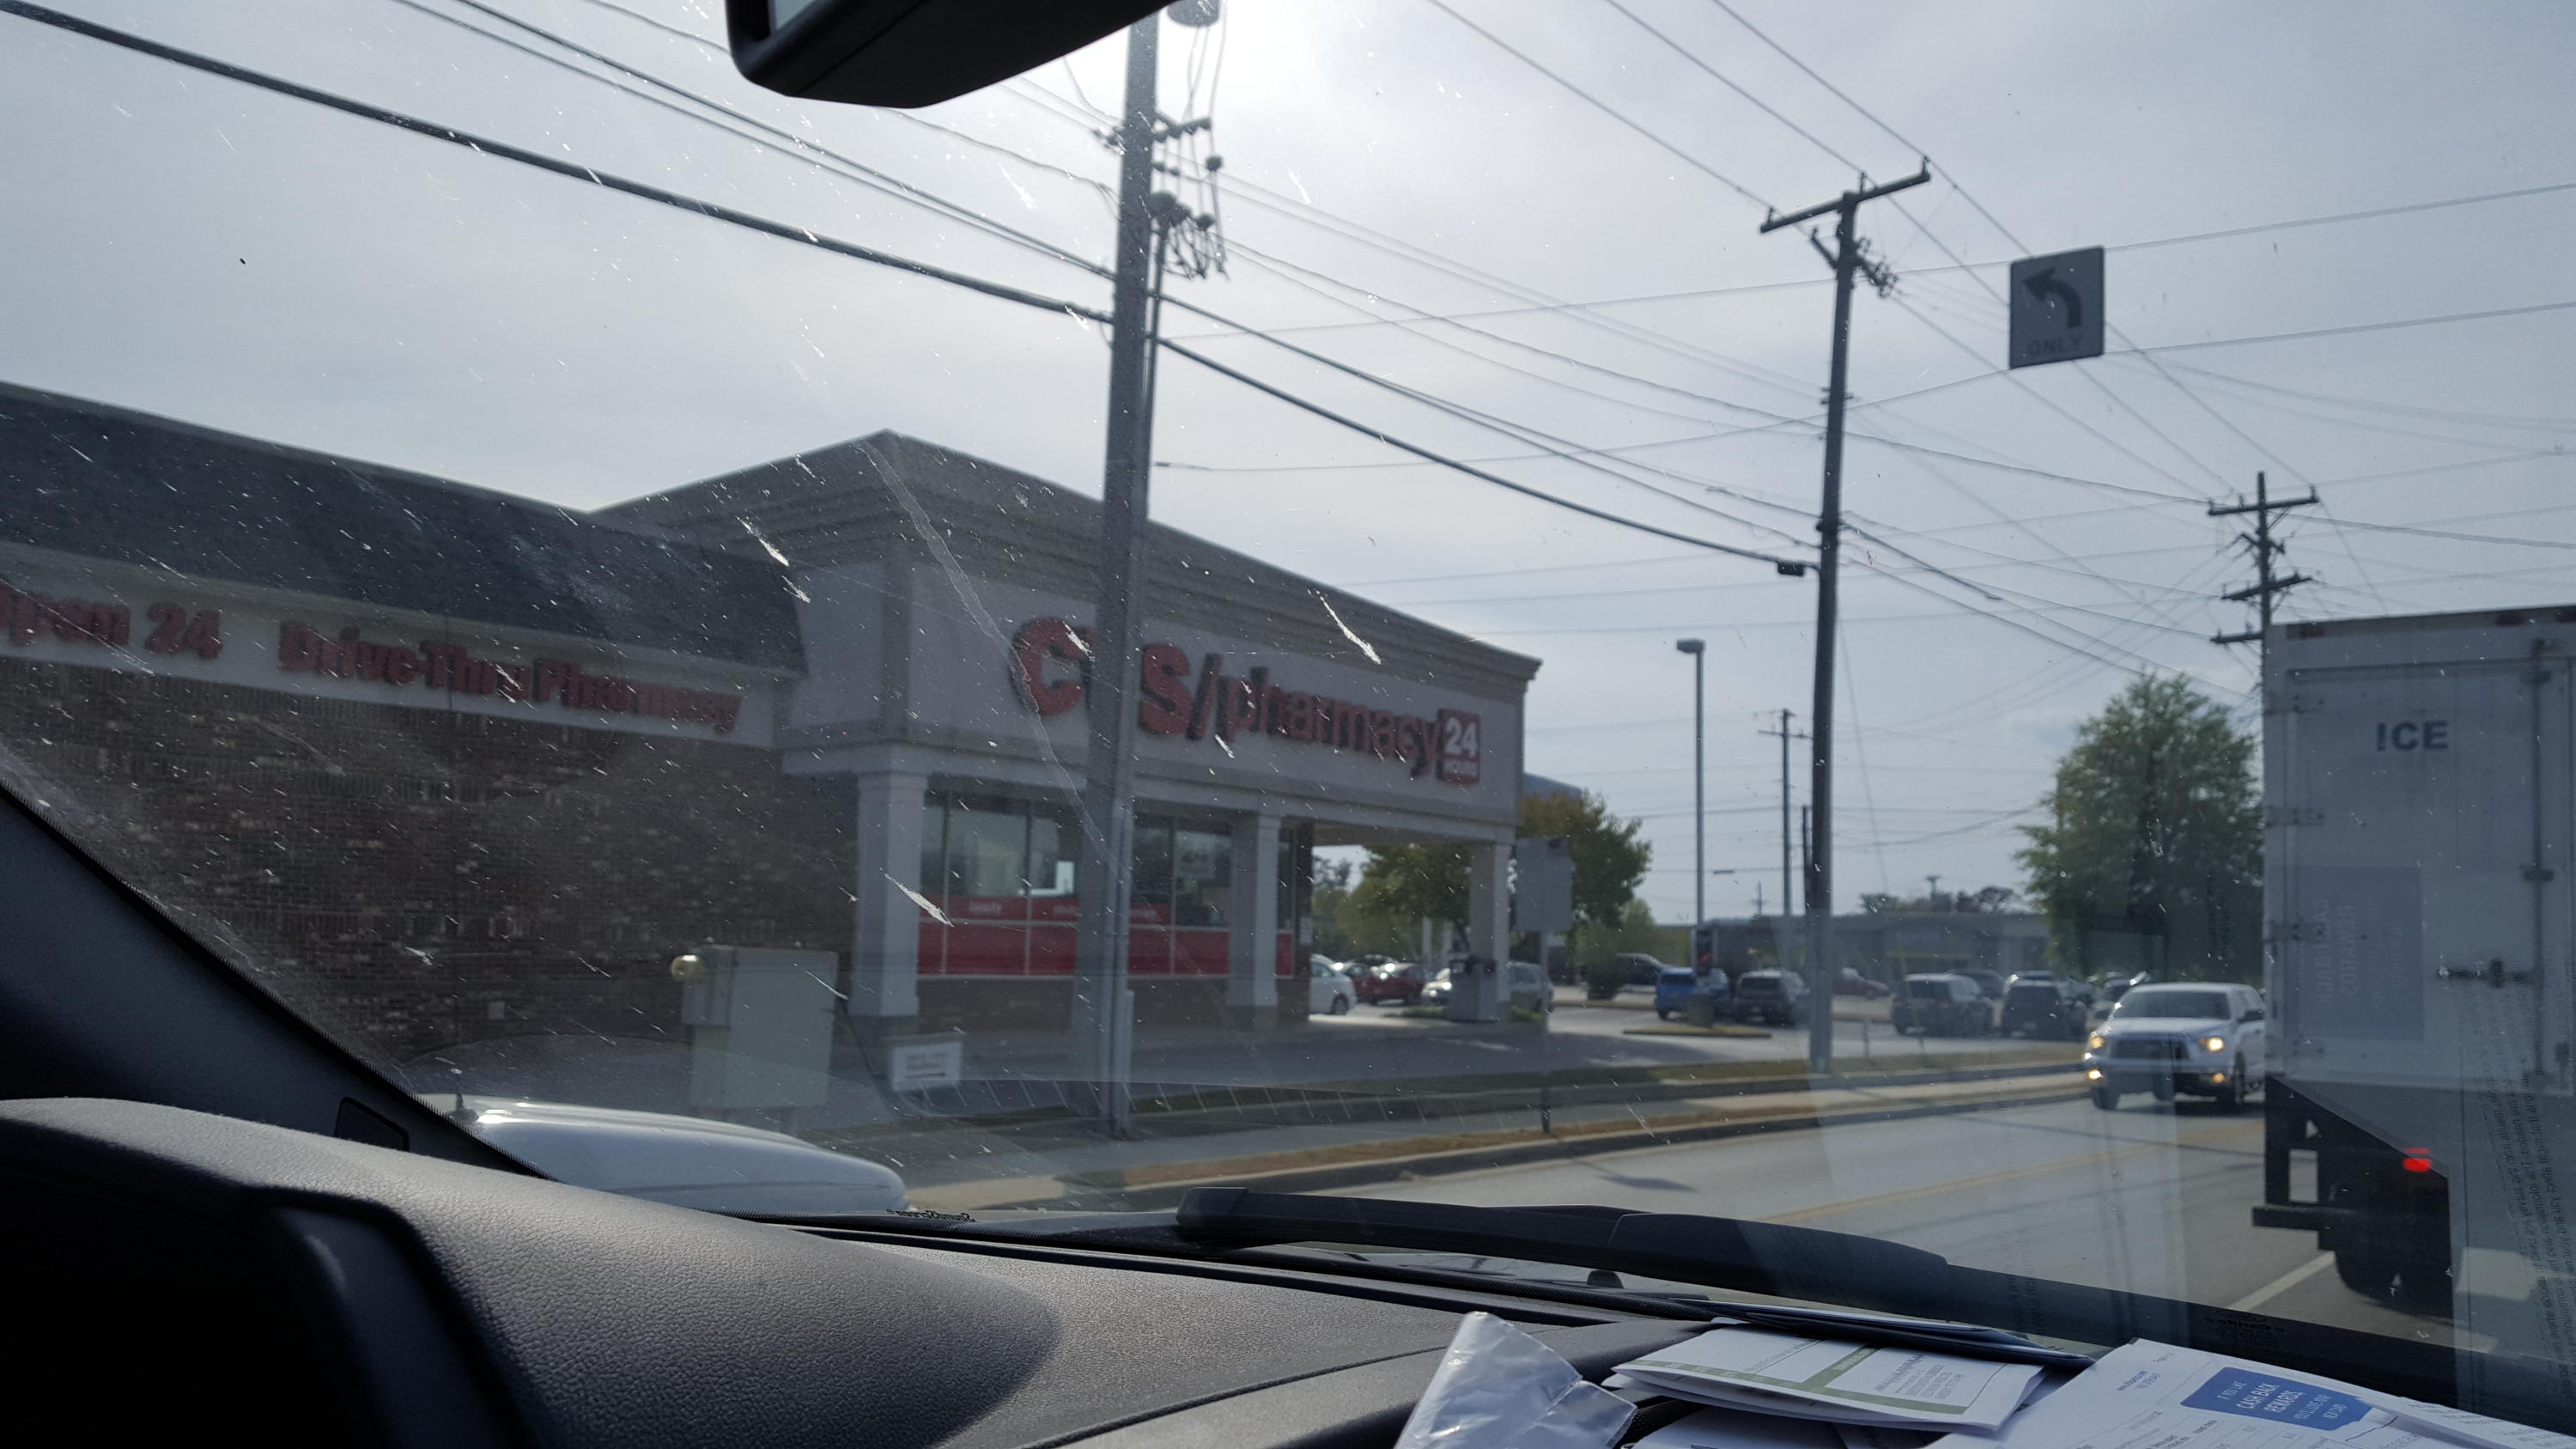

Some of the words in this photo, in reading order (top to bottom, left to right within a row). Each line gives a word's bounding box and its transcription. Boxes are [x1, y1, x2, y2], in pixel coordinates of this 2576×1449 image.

[2027, 333, 2082, 356] ONLY
[144, 601, 223, 659] 24
[279, 622, 530, 702] Drive-Thru
[1444, 717, 1478, 757] 24
[2376, 721, 2449, 751] ICE
